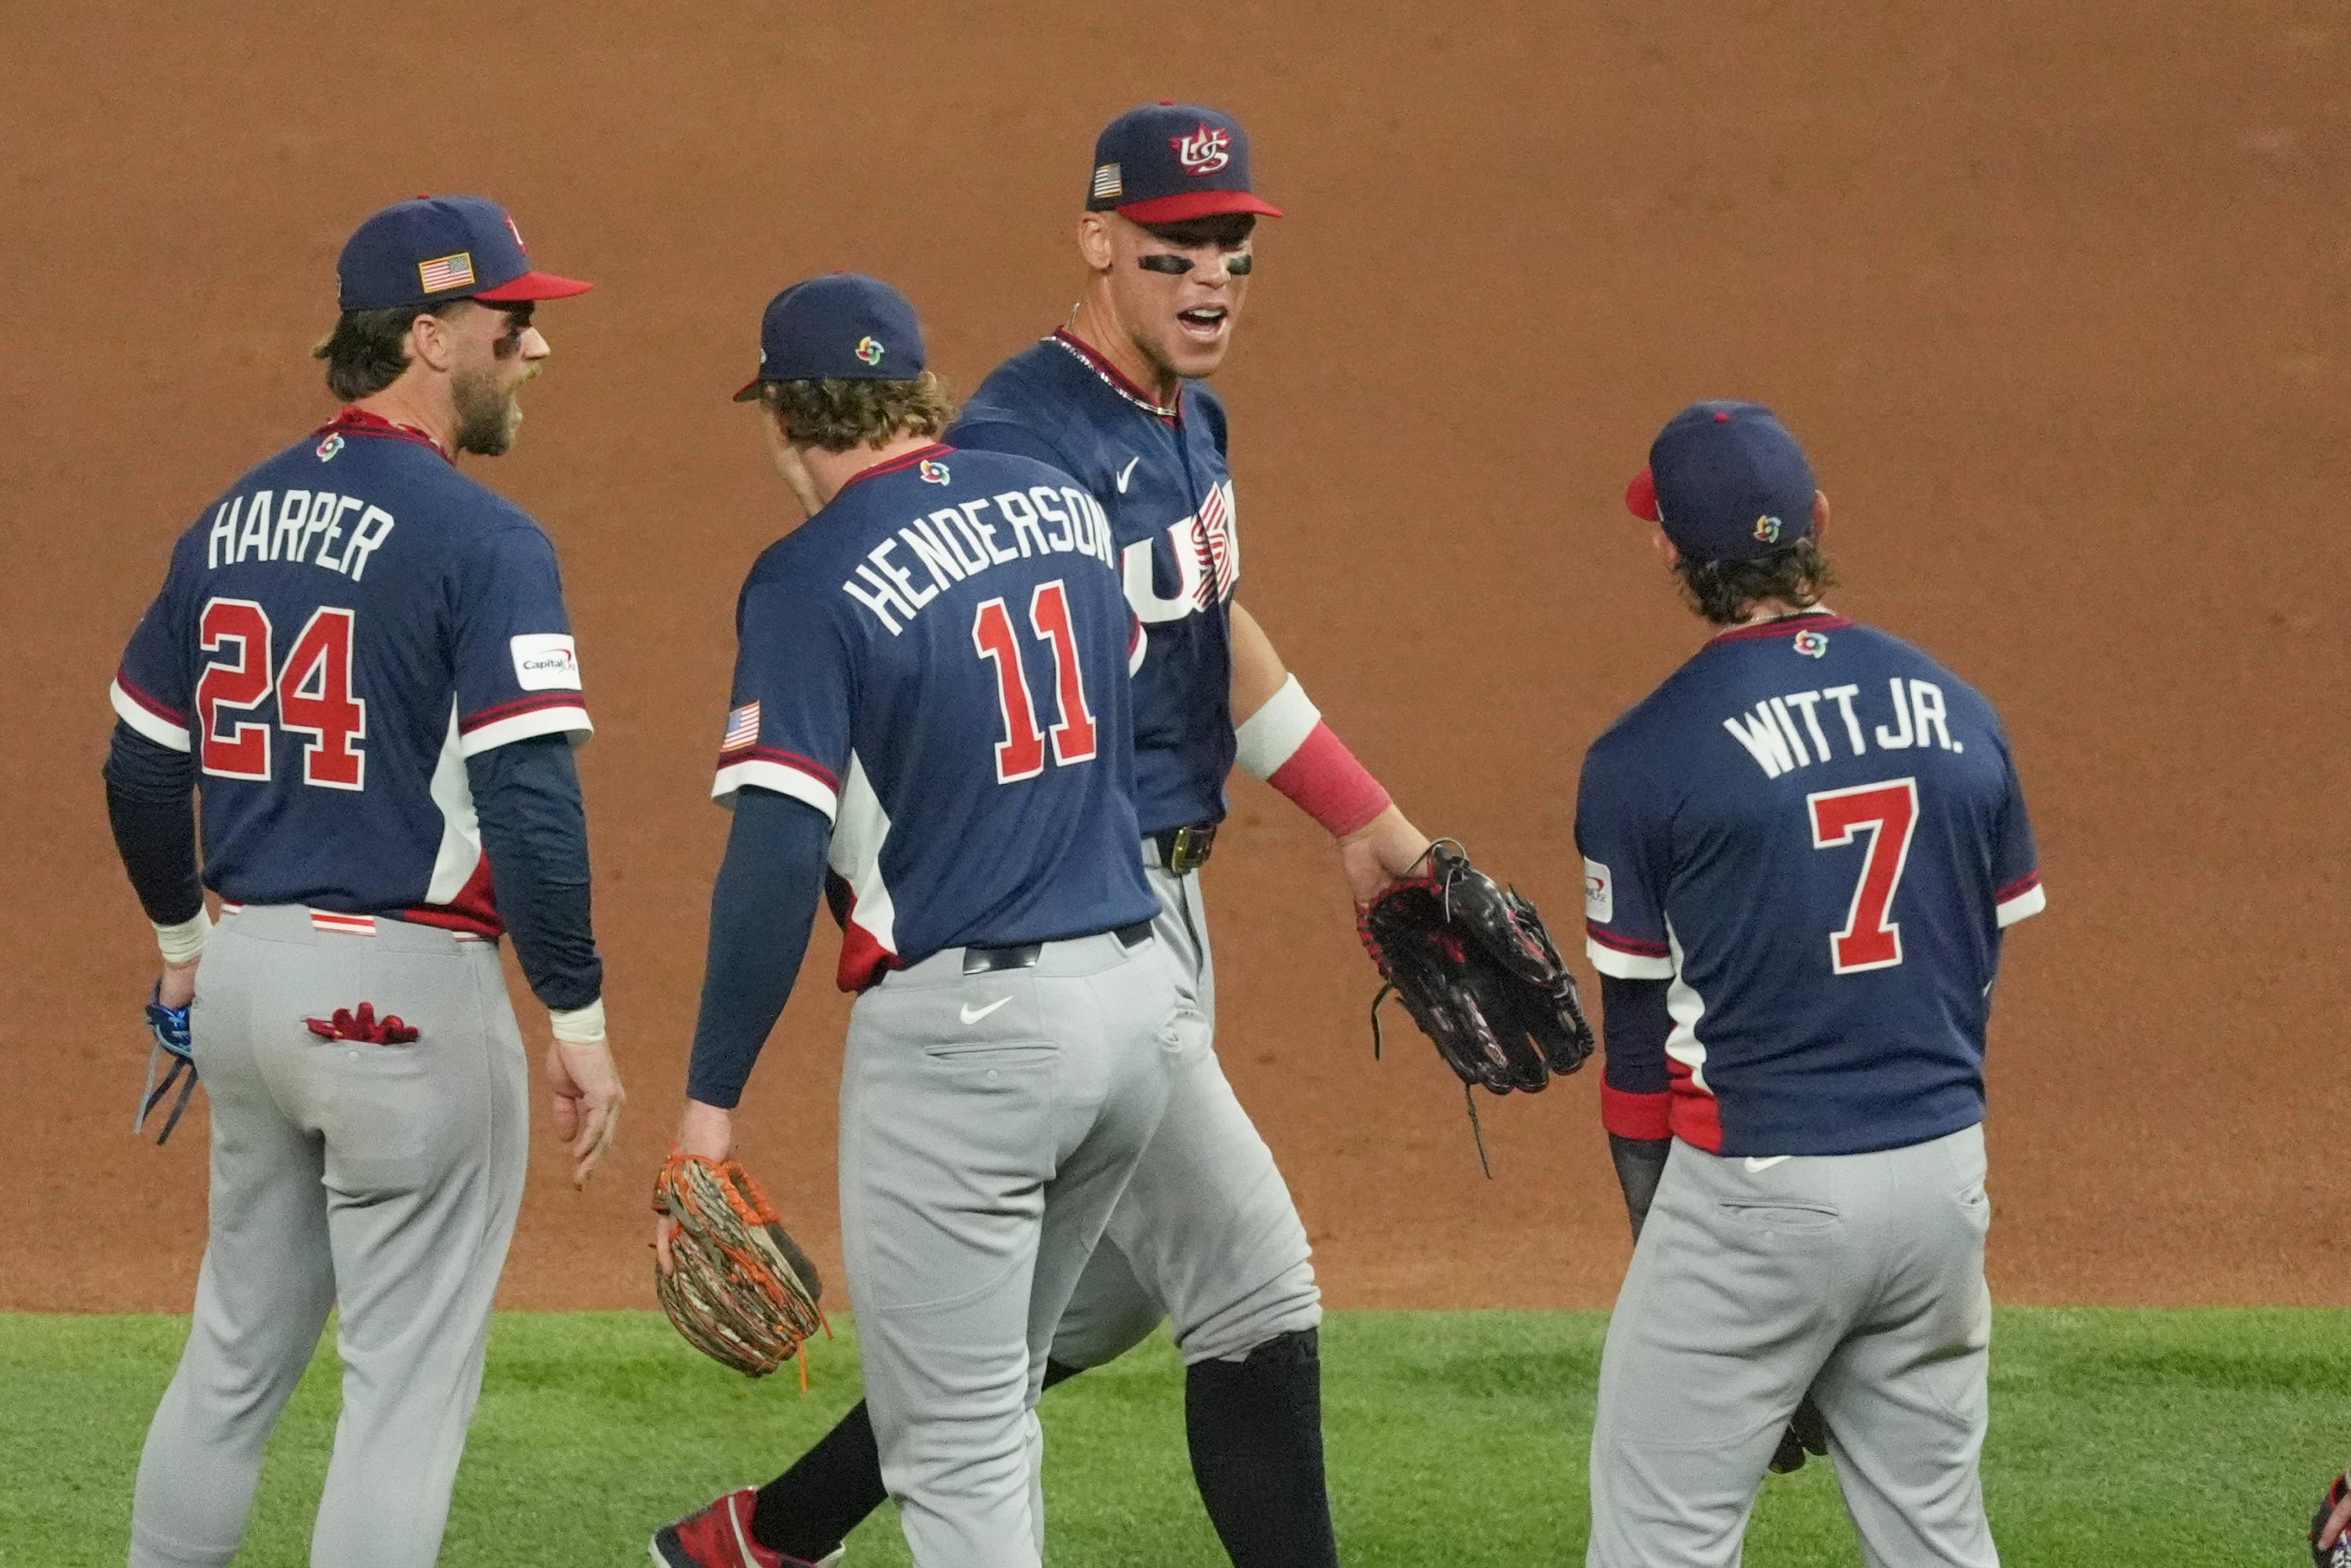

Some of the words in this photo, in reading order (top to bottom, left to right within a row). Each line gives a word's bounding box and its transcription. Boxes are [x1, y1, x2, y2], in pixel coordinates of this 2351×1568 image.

[208, 488, 395, 583] HARPER
[842, 486, 1114, 637] HENDERSON
[196, 597, 366, 792] 24
[523, 659, 563, 670] Capital
[971, 578, 1097, 785] 11
[1722, 684, 1867, 780] WITT
[1875, 677, 1965, 754] JR.
[1806, 776, 1919, 975] 7
